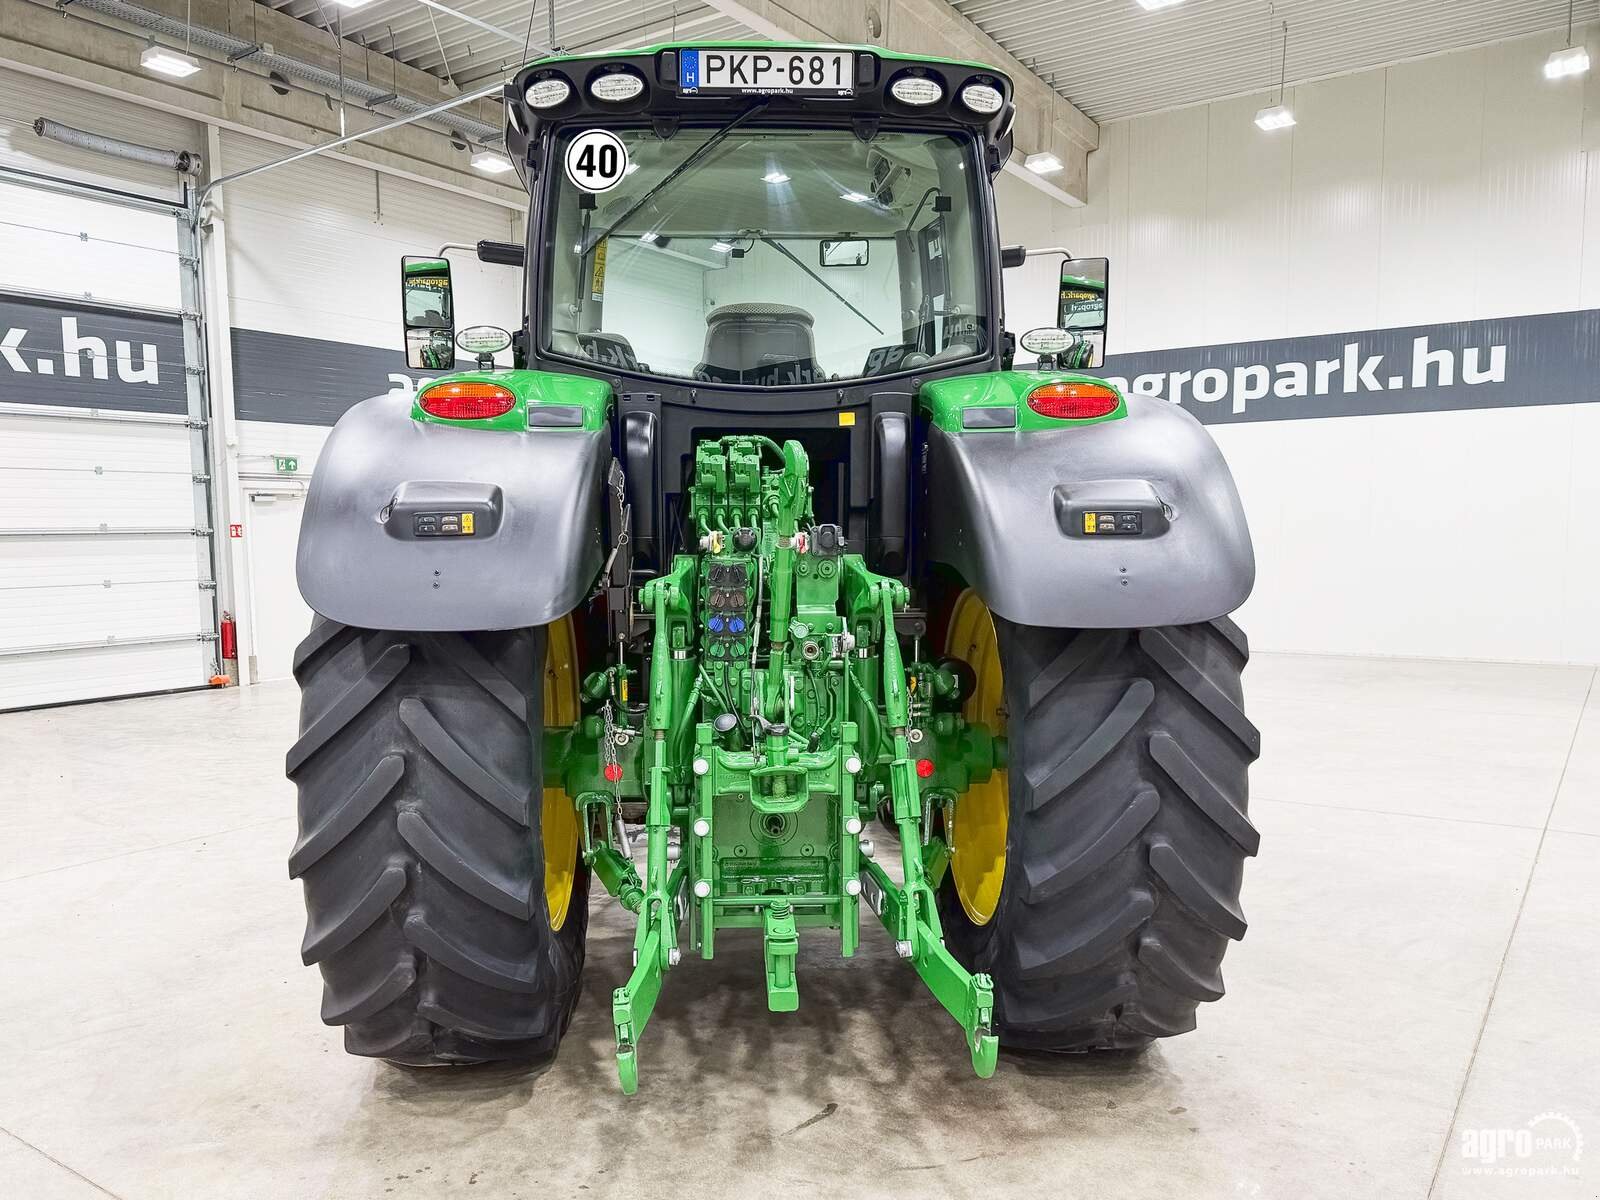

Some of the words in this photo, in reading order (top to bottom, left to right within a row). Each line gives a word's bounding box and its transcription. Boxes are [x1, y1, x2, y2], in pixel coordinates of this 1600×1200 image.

[686, 72, 695, 83] H
[706, 55, 841, 86] PKP-681
[576, 144, 618, 178] 40
